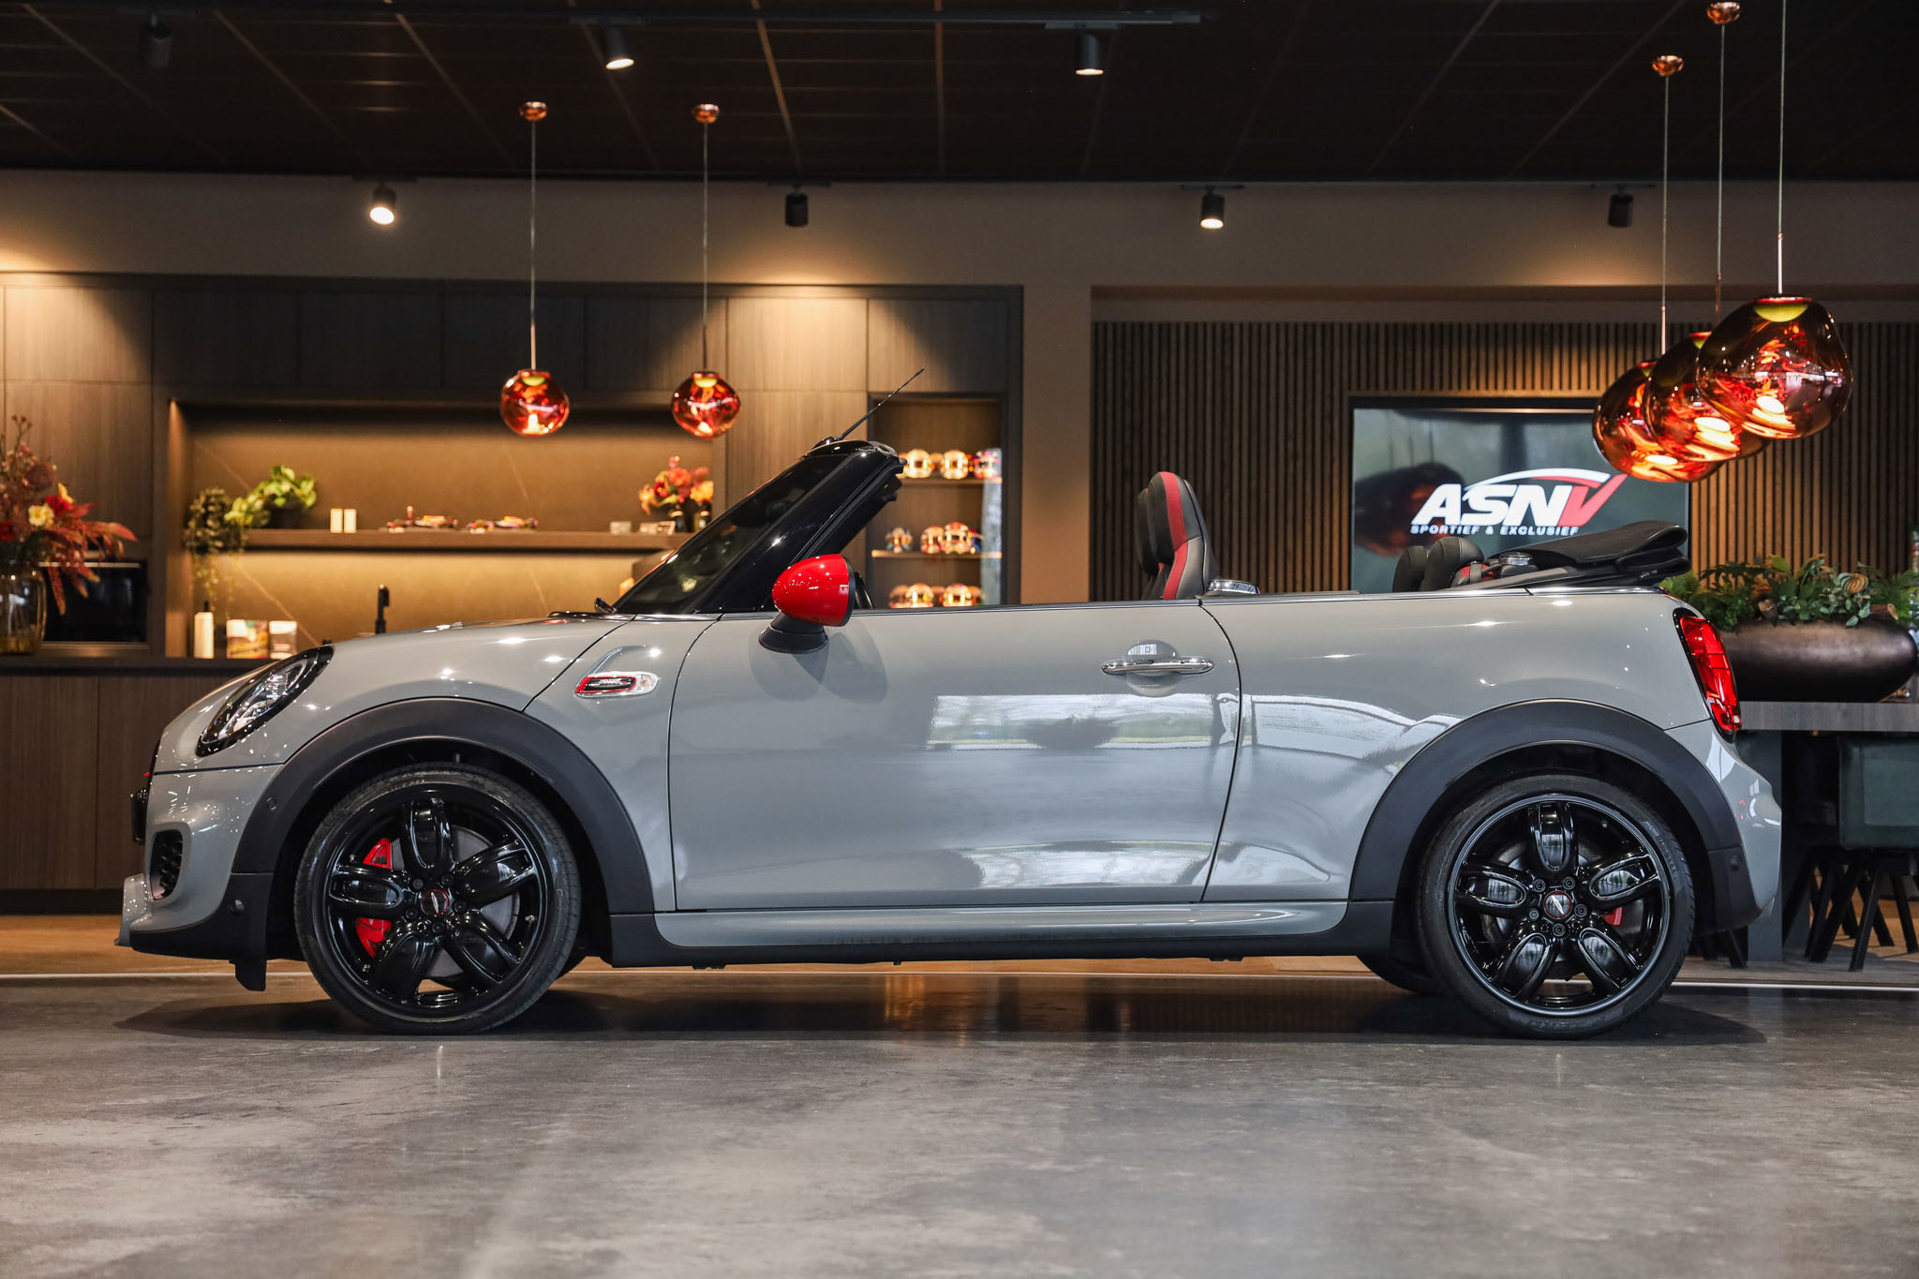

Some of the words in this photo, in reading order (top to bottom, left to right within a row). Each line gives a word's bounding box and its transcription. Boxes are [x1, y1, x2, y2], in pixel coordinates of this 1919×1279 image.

[1411, 474, 1628, 527] ASNV
[1410, 525, 1480, 535] SPORTIEF
[1500, 526, 1579, 536] EXCLUSIEF
